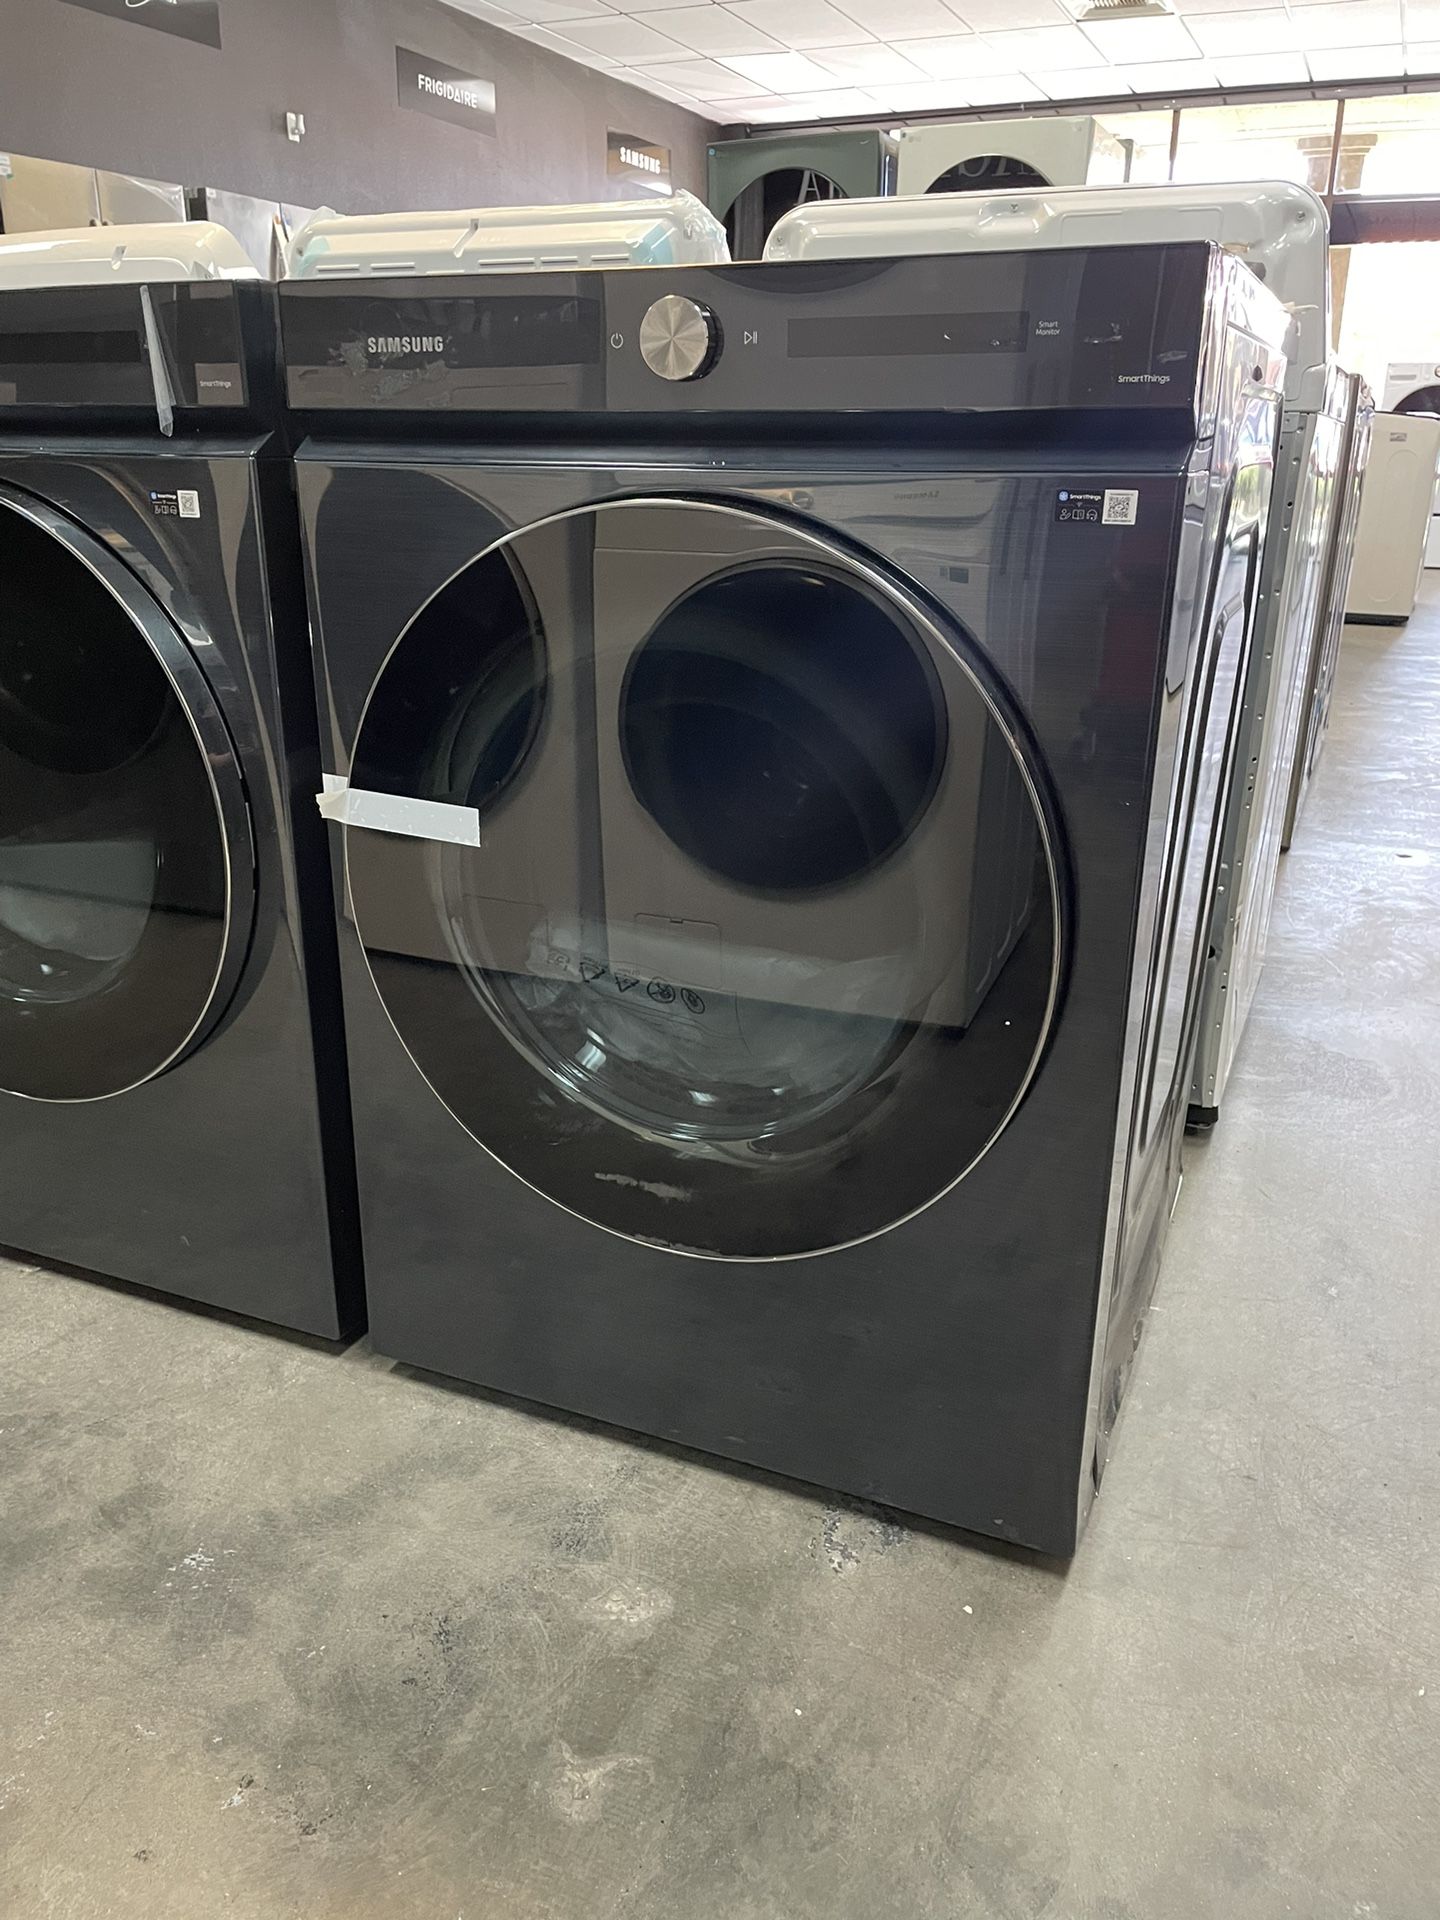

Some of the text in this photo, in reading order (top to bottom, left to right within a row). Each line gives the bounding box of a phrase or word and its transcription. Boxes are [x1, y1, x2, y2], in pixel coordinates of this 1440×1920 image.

[417, 73, 478, 109] FRIGIDAIRE
[620, 146, 661, 175] SAMSUNG
[1038, 320, 1059, 328] Smart
[1035, 328, 1061, 336] Monitor
[367, 336, 444, 353] SAMSUNG
[1117, 374, 1171, 385] SmartThings
